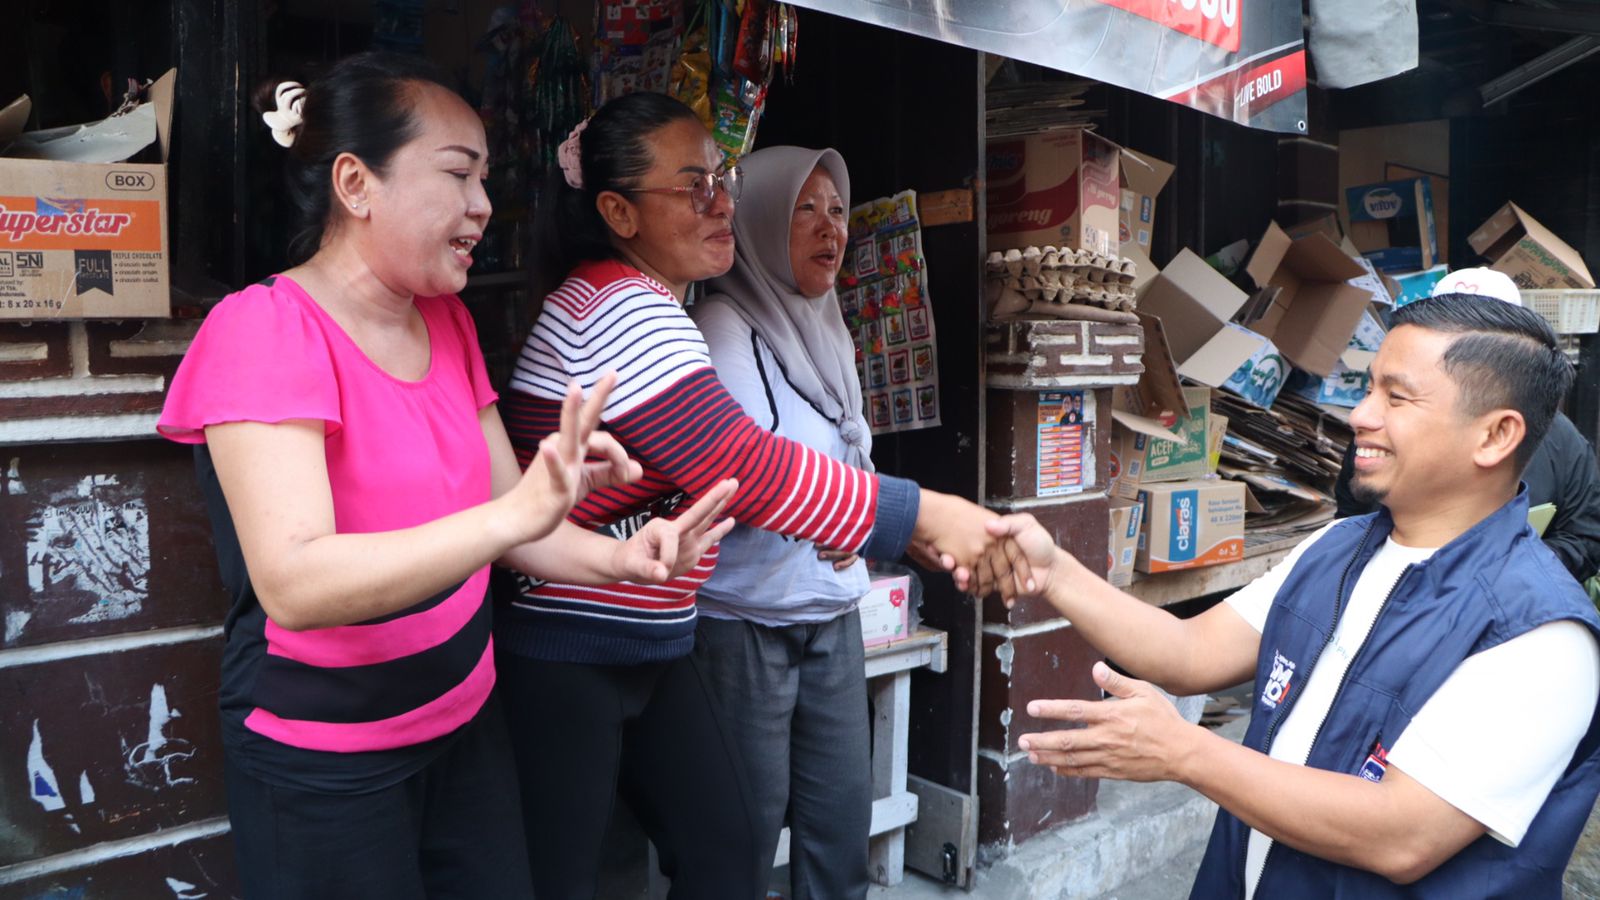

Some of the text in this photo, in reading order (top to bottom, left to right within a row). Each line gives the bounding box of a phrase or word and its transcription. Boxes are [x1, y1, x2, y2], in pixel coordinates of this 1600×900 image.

[1239, 69, 1282, 107] LIVE BOLD
[115, 175, 145, 187] BOX
[17, 253, 43, 268] SNI
[79, 259, 109, 273] FULL
[23, 300, 33, 308] 20
[1151, 440, 1173, 457] ACEH
[1176, 496, 1191, 551] claras
